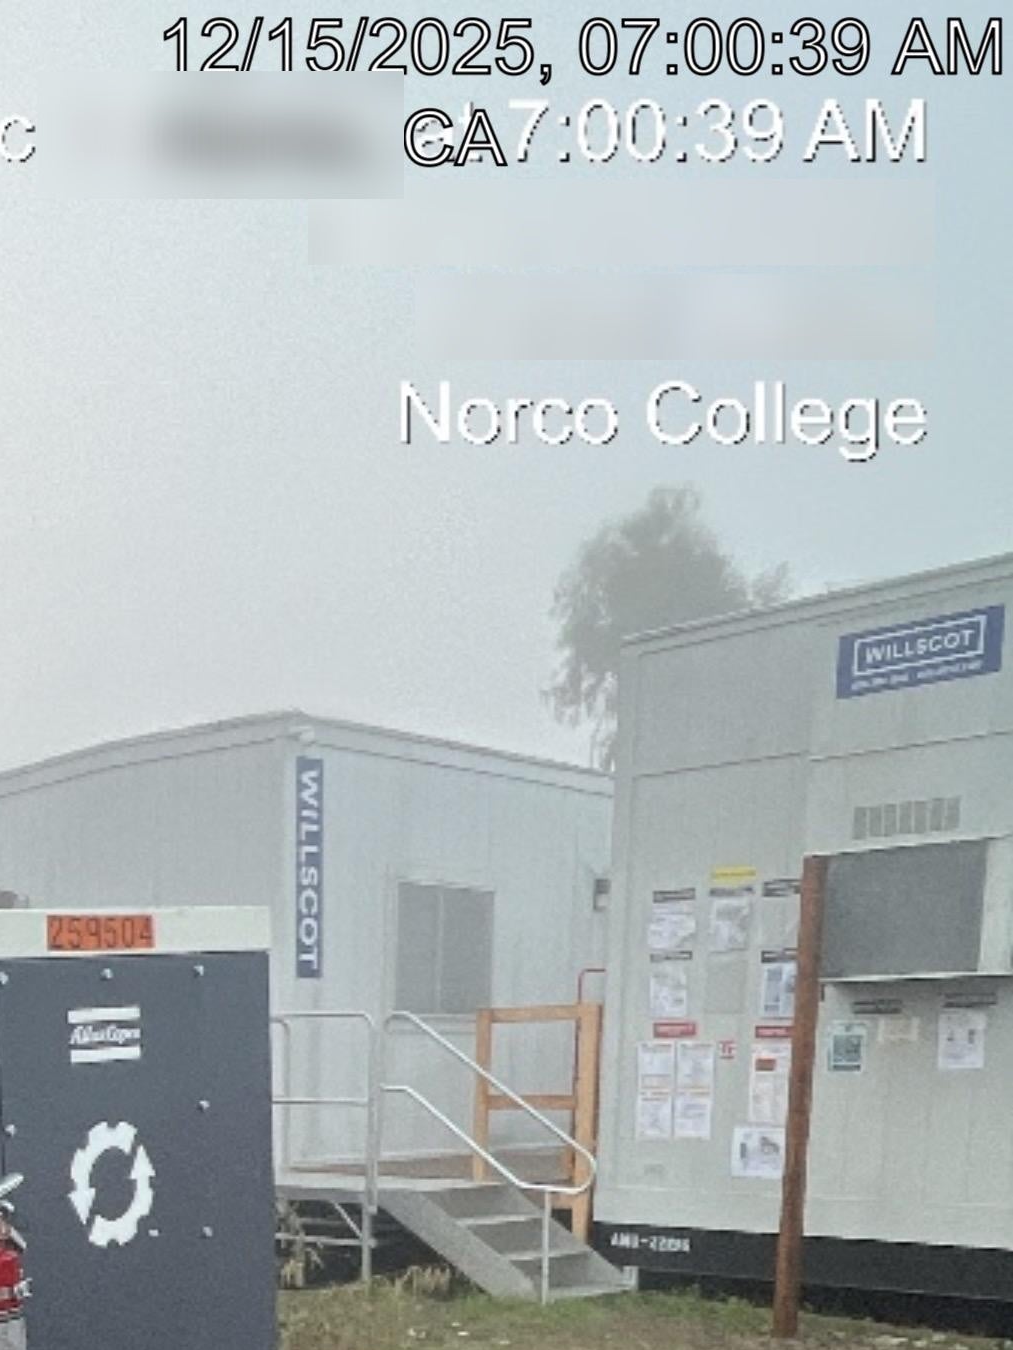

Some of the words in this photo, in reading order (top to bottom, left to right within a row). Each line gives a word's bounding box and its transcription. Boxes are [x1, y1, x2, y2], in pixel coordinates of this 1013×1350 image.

[865, 629, 976, 665] WILLSCOT
[299, 769, 320, 970] WILLSCOT
[49, 917, 153, 949] 259504
